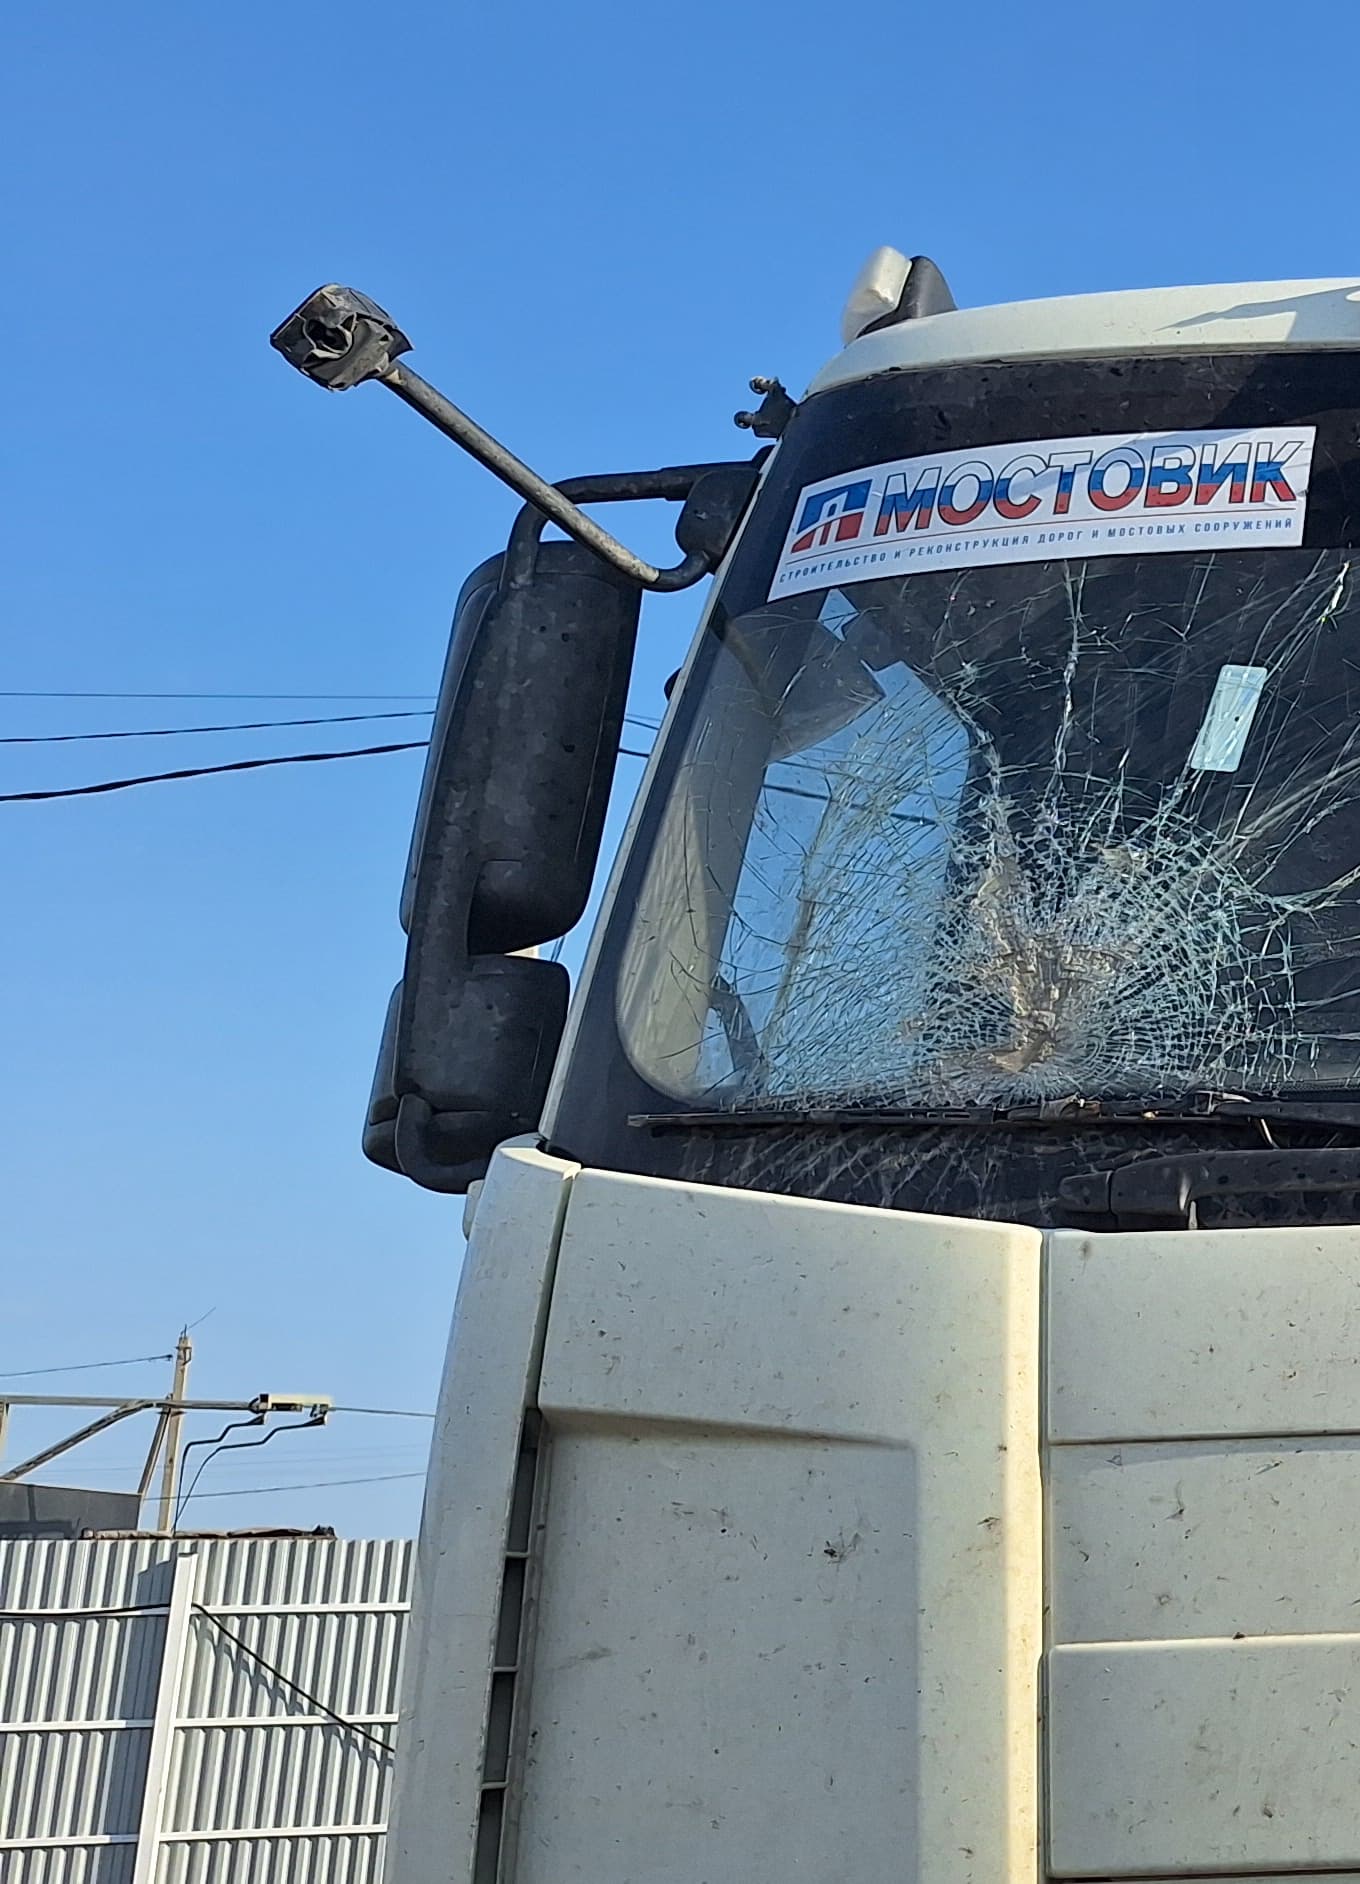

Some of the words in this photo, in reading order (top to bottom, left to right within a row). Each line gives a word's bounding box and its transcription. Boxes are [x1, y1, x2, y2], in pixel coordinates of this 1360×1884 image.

[874, 441, 1303, 537] МОСТОВИК
[779, 553, 886, 583] СТРОИТЕЛЬСТВО
[893, 550, 902, 560] И
[909, 535, 1029, 557] РЕКОНСТРУКЦИЯ
[1038, 530, 1083, 544] ДОРОГ
[1092, 529, 1098, 538] И
[1107, 523, 1186, 537] МОСТОВЫХ
[1194, 517, 1293, 533] СООРУЖЕНИЙ
